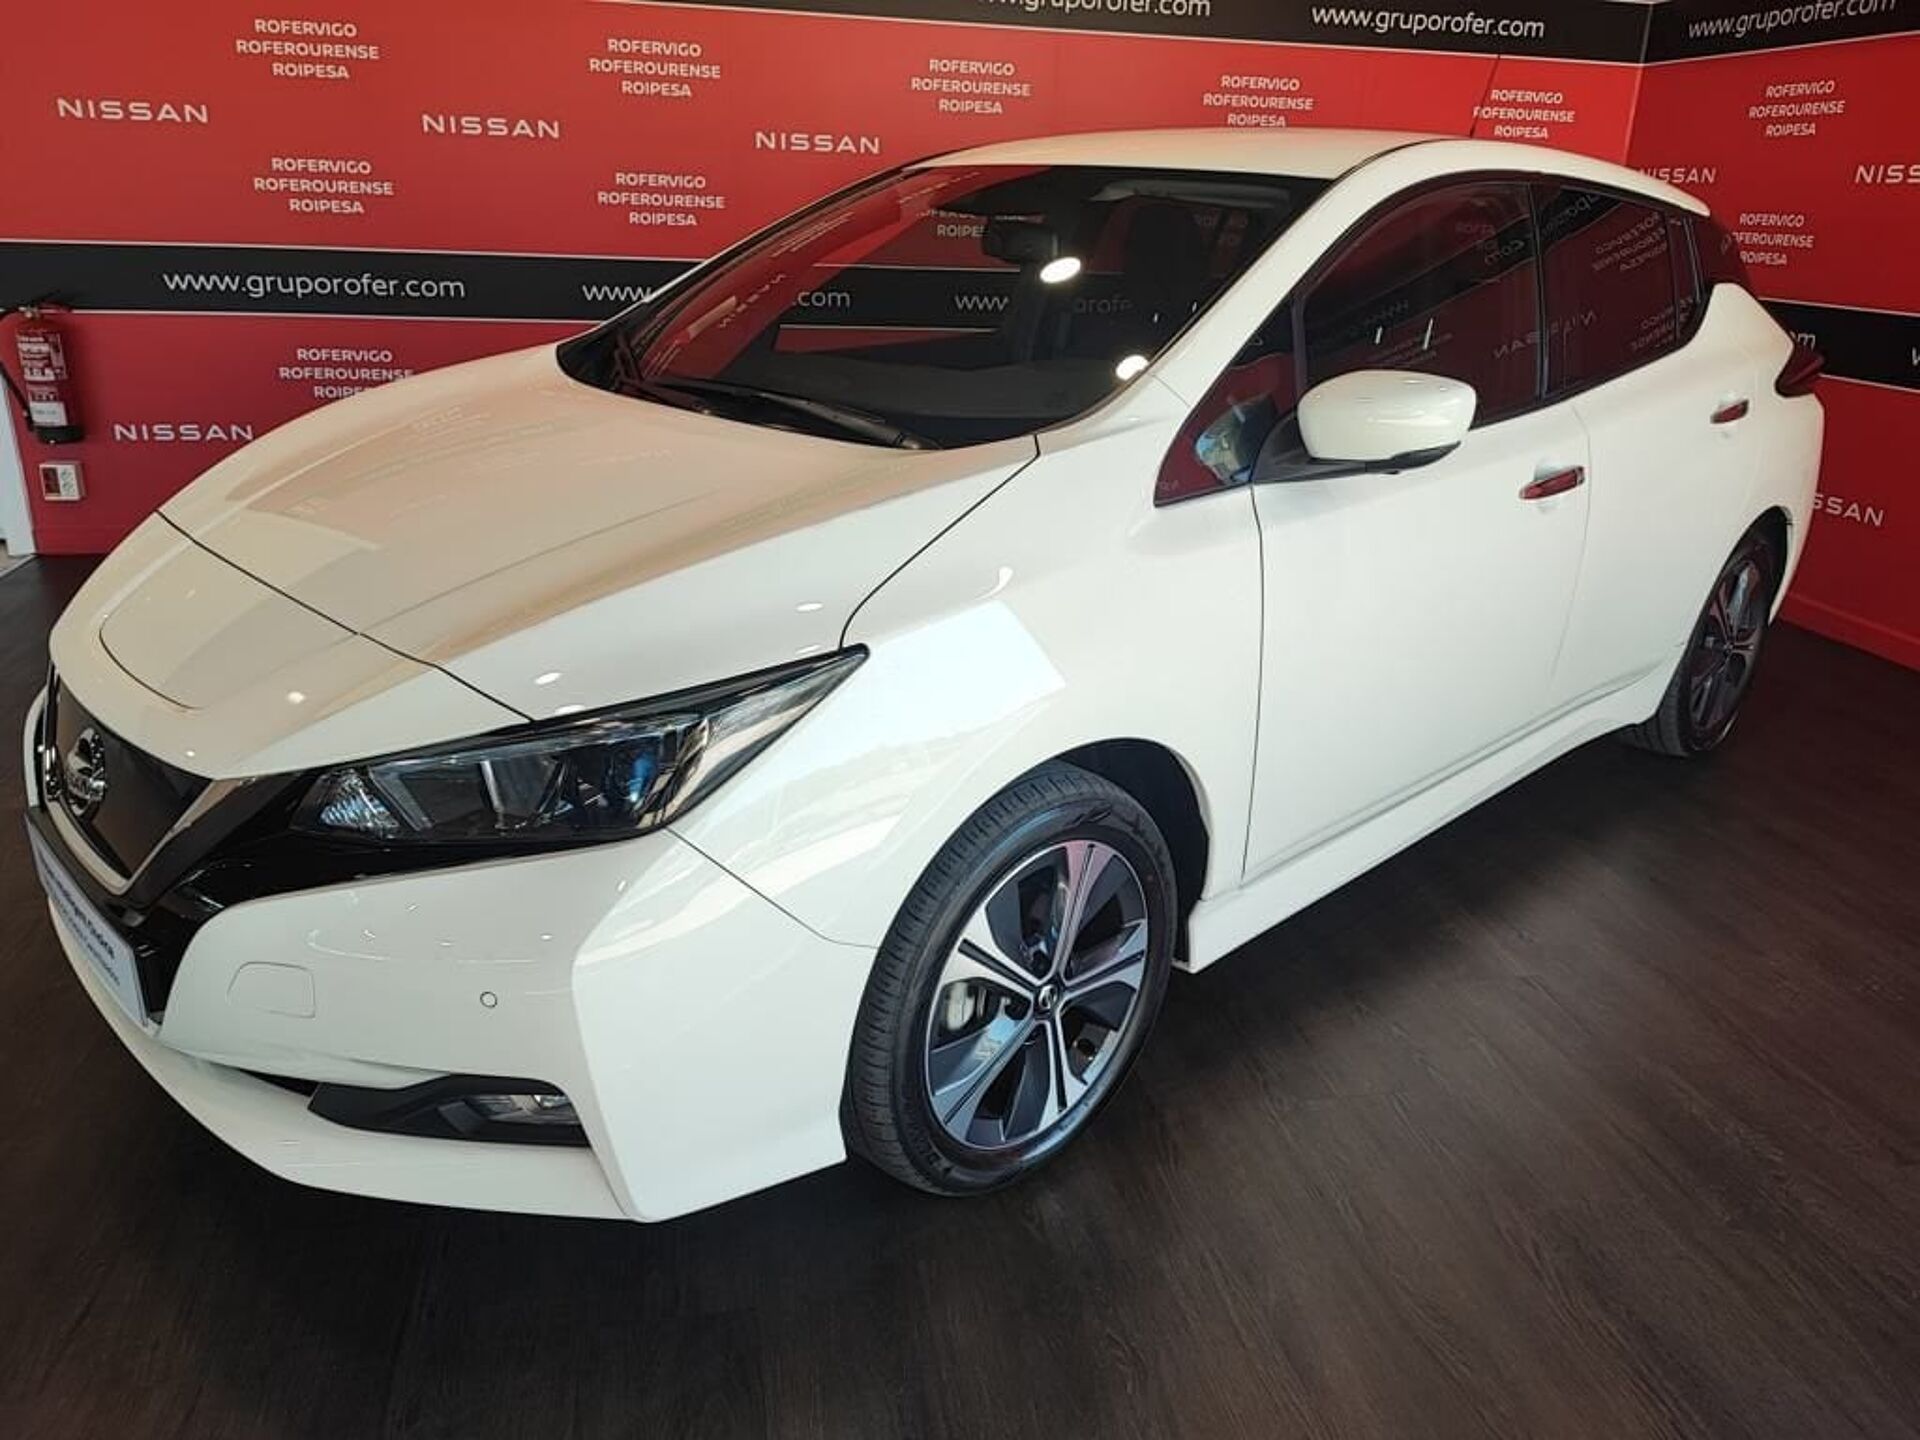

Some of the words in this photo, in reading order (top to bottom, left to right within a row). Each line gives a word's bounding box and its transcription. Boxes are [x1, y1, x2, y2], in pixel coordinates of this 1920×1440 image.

[988, 0, 1210, 16] .gporoer.com
[1312, 7, 1545, 37] www.gruporofer.com
[1688, 0, 1896, 38] www.gruporofer.com
[254, 18, 357, 38] ROFERVIGO
[236, 39, 379, 60] ROFEROURENSE
[607, 38, 702, 57] ROFERVIGO
[272, 62, 349, 79] ROIPESA
[589, 58, 721, 79] ROFEROURENSE
[929, 59, 1015, 76] ROFERVIGO
[621, 80, 692, 97] ROIPESA
[911, 77, 1030, 96] ROFEROURENSE
[1221, 75, 1300, 91] ROFERVIGO
[1765, 80, 1835, 98] ROFERVIGO
[1203, 92, 1313, 110] ROFEROURENSE
[1490, 89, 1563, 104] ROFERVIGO
[57, 98, 208, 123] NISSAN
[939, 98, 1003, 114] ROIPESA
[1473, 106, 1576, 122] ROFEROURENSE
[1749, 100, 1846, 119] ROFEROURENSE
[422, 114, 560, 139] NISSAN
[1227, 113, 1286, 127] ROIPESA
[1494, 125, 1548, 139] ROIPESA
[1766, 123, 1816, 137] ROIPESA
[755, 131, 880, 154] NISSAN
[271, 157, 371, 174] ROFERVIGO
[253, 177, 393, 196] ROFEROURENSE
[615, 172, 706, 189] ROFERVIGO
[289, 198, 364, 214] ROIPESA
[597, 191, 725, 209] ROFEROURENSE
[629, 211, 697, 226] ROIPESA
[1739, 213, 1805, 228] ROFERVIGO
[1740, 250, 1788, 265] ROIPESA
[163, 272, 465, 298] www.gruporofer.com
[297, 348, 393, 363] ROFERVIGO
[113, 423, 254, 441] NISSAN
